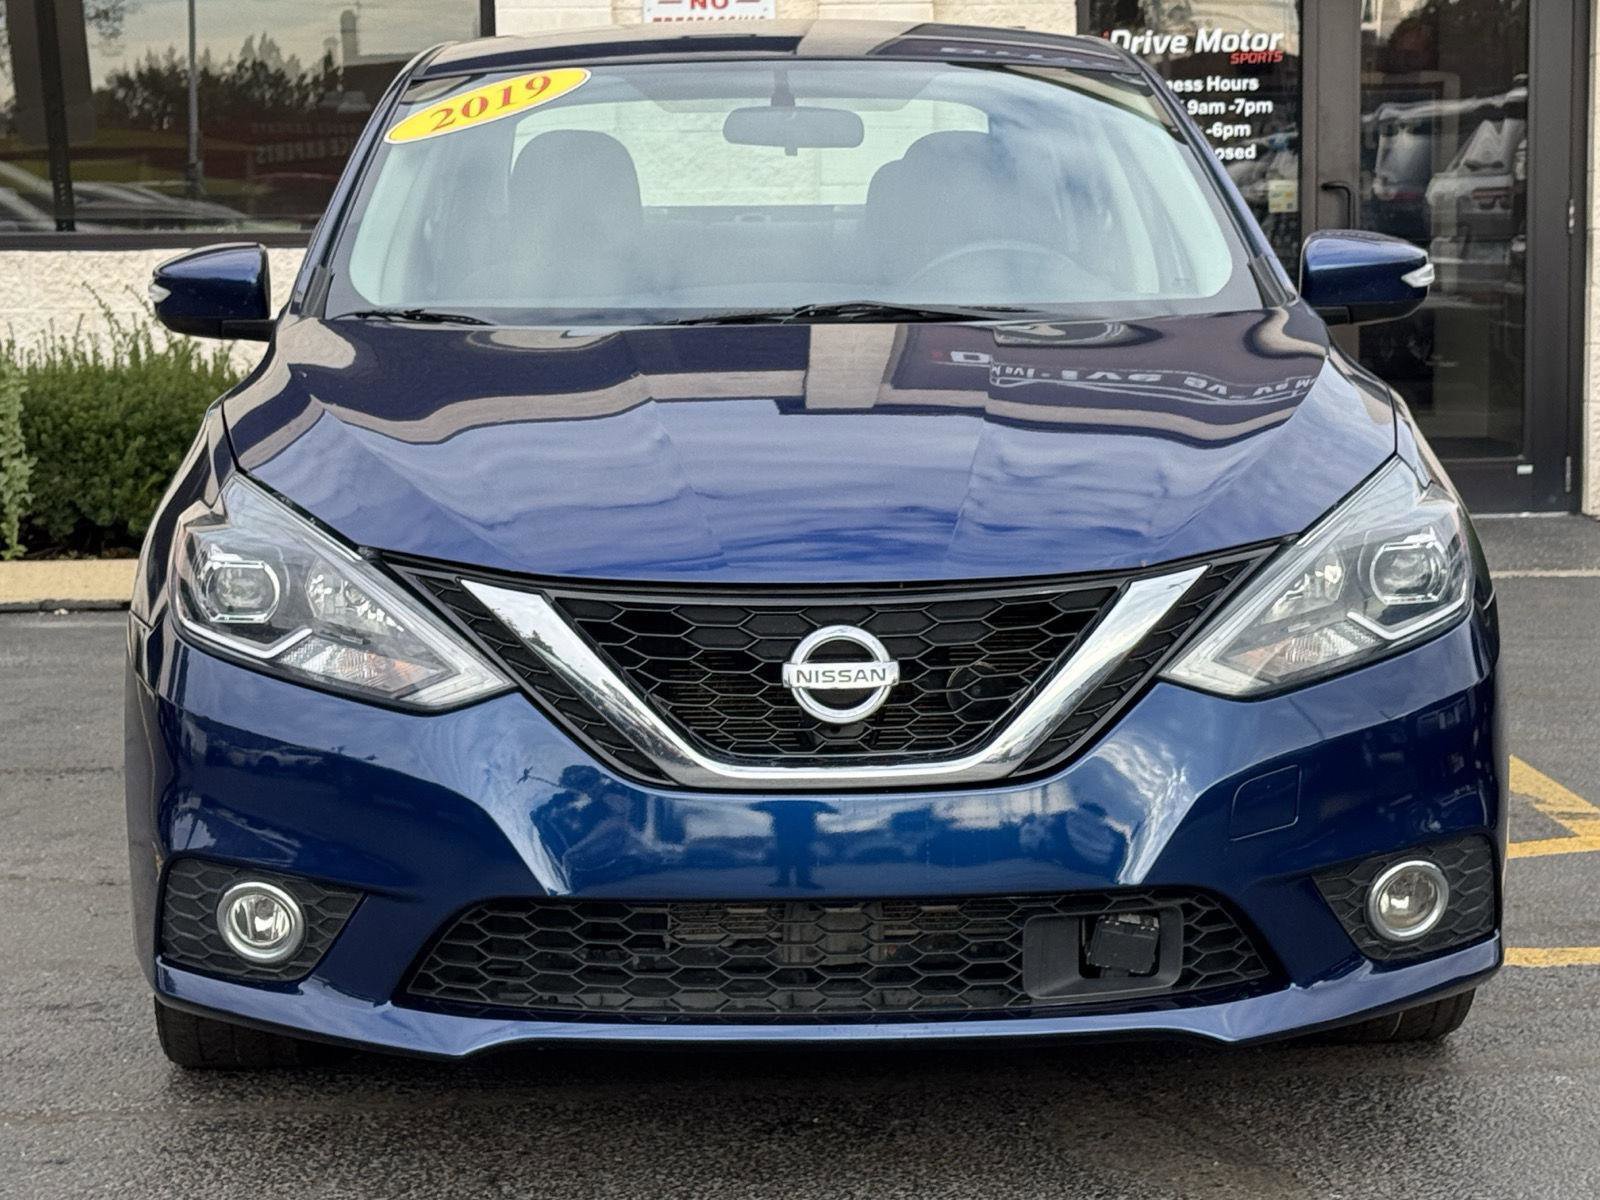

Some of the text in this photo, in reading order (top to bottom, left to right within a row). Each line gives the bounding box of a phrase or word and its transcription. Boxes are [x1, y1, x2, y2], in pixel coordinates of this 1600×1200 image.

[1195, 27, 1285, 53] Motor
[1230, 50, 1284, 65] SPORTS
[1207, 75, 1260, 92] Hours
[430, 76, 551, 132] 2019
[1187, 98, 1274, 117] 9am -7pm
[1205, 121, 1252, 141] -6pm
[796, 668, 886, 683] NISSAN
